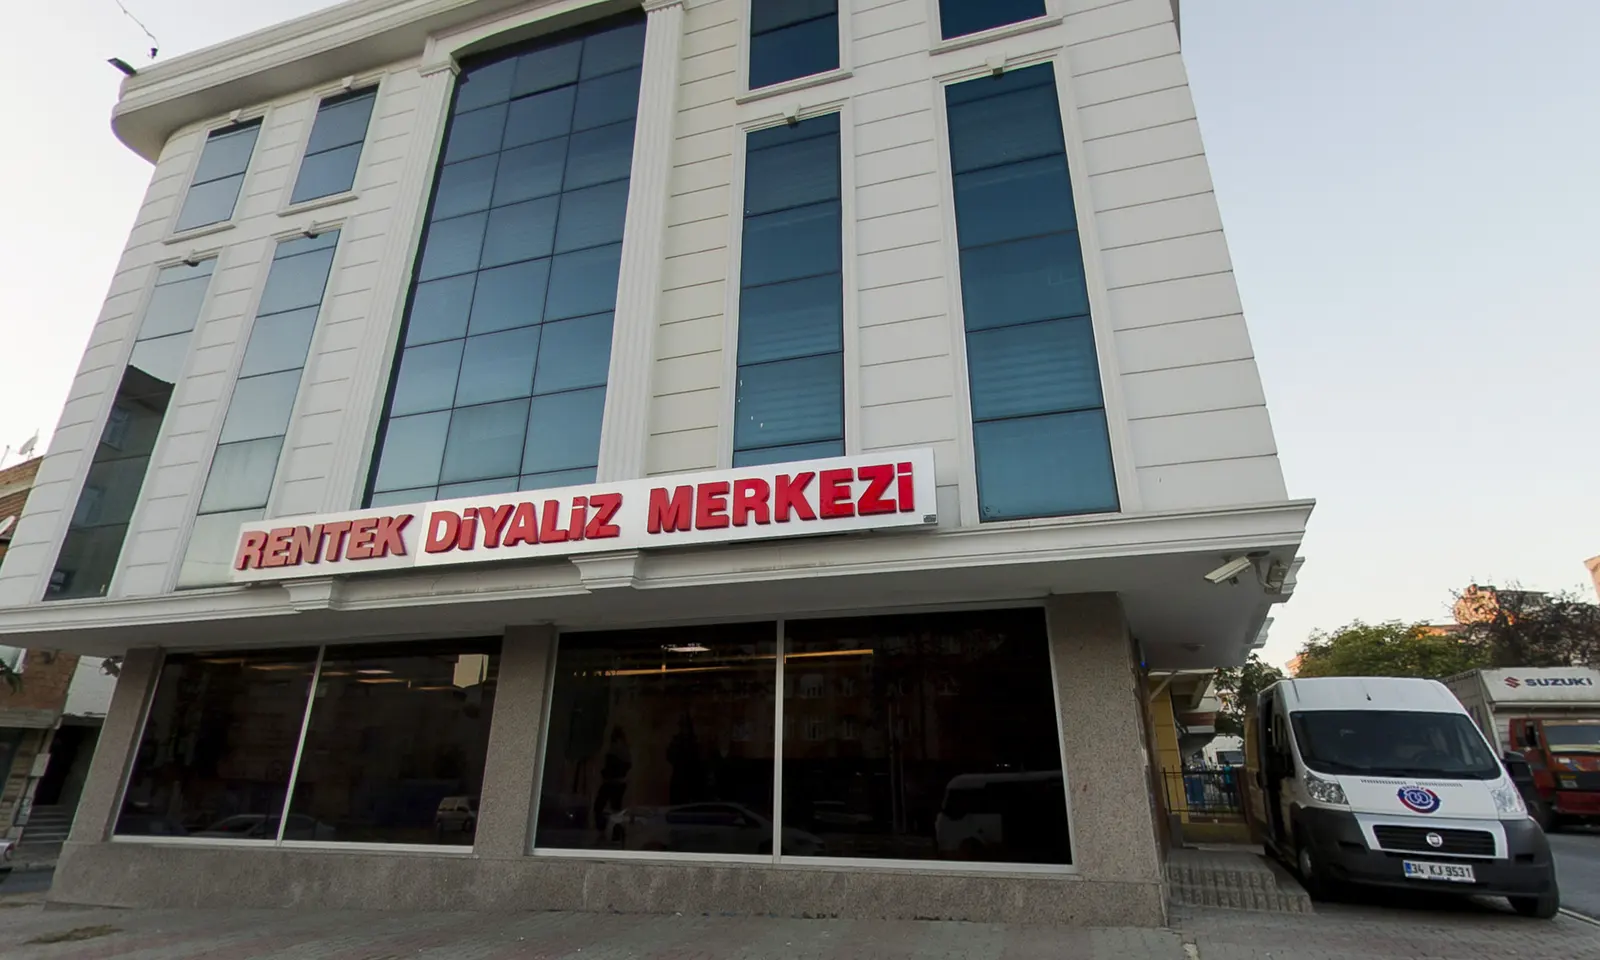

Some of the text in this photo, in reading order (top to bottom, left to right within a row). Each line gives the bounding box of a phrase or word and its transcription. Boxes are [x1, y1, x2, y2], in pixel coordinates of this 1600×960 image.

[234, 514, 414, 570] RENTEK
[1524, 677, 1593, 687] SUZUKI
[1411, 863, 1425, 874] 34
[1429, 865, 1443, 876] KJ
